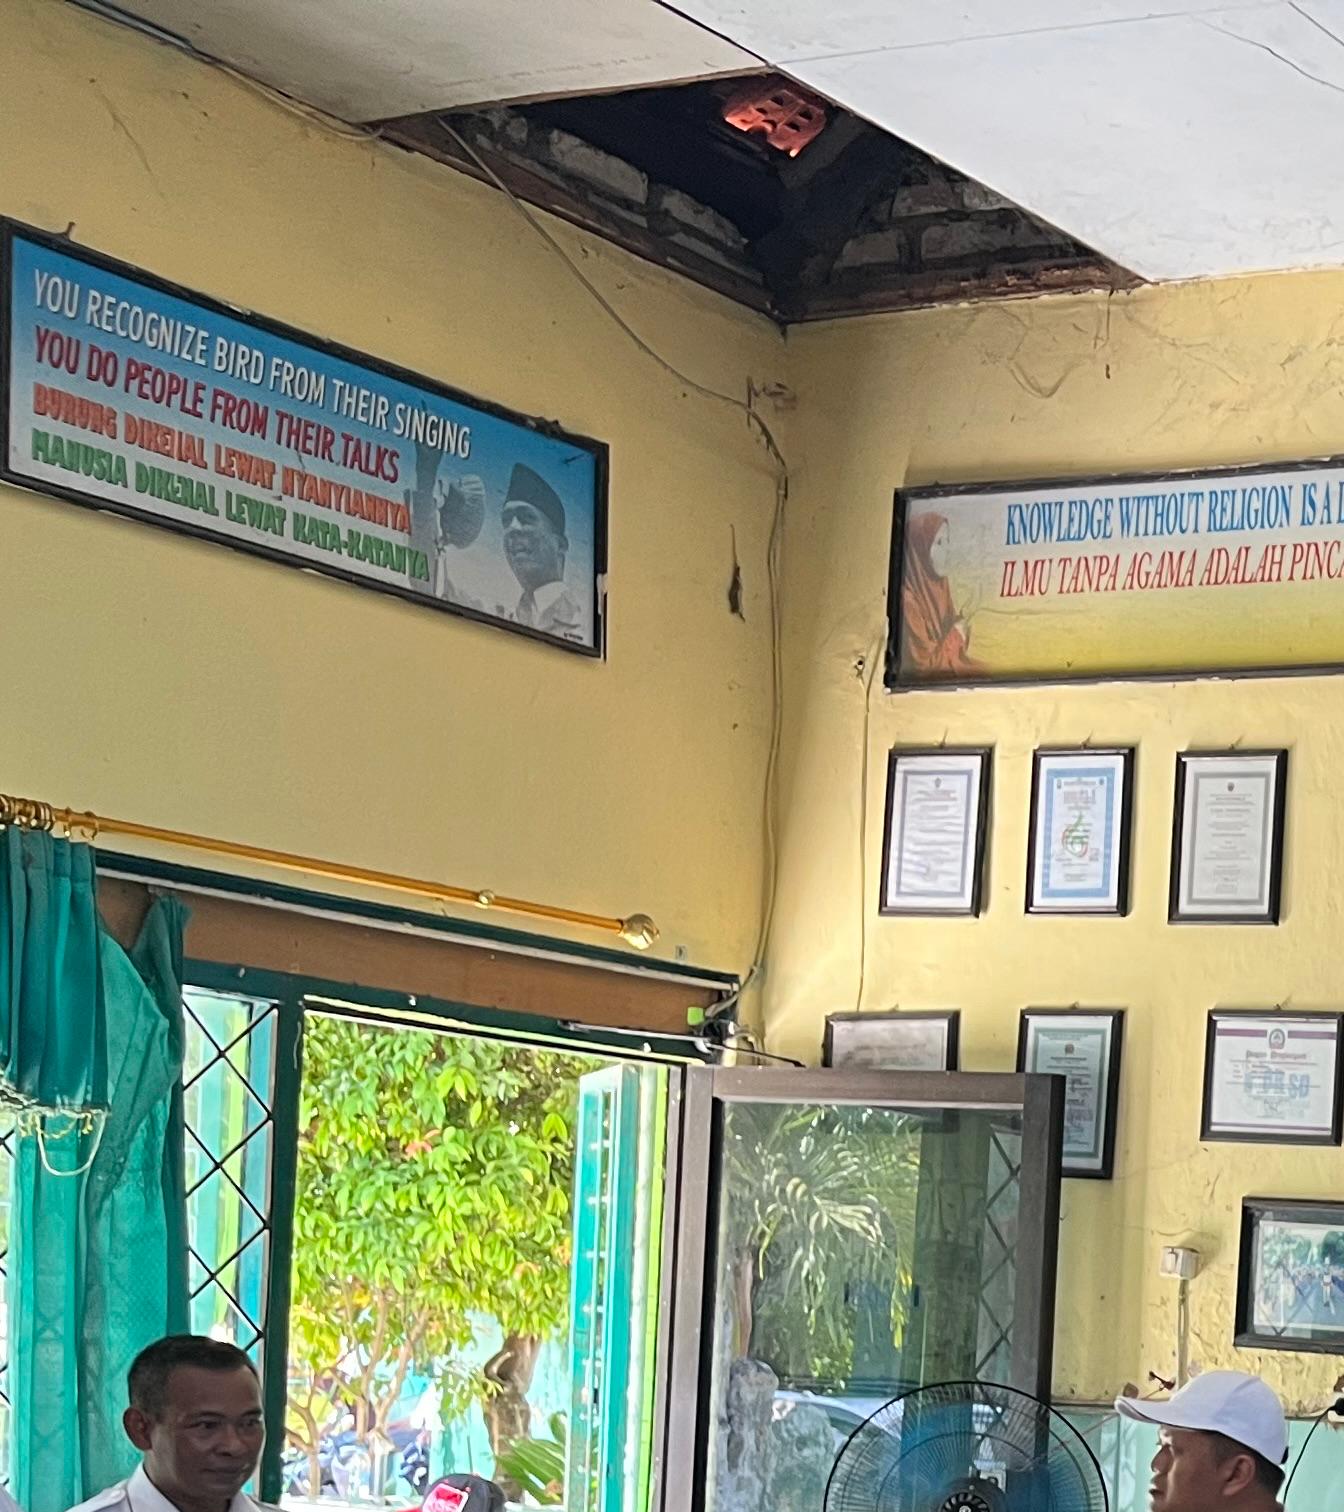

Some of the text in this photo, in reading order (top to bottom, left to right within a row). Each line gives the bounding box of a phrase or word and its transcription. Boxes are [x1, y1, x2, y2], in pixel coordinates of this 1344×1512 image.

[34, 269, 472, 460] YOU RECOGNIZE BIRD FROM THEIR SINGING
[35, 325, 400, 485] YOU DO PEOPLE FROM THEIR TALKS
[32, 428, 430, 582] MANUSIA DIKENAL LEWAT KATA-KATANYA
[214, 443, 277, 491] LEWAT
[1005, 497, 1114, 546] KNOWLEDGE
[1117, 491, 1205, 541] WITHOUT
[1206, 485, 1293, 534] RELIGION
[1300, 483, 1318, 526] IS
[1319, 482, 1334, 525] A
[1000, 557, 1053, 598] ILMU
[1057, 553, 1120, 595] TANPA
[1121, 548, 1197, 590] AGAMA
[1199, 543, 1288, 588] ADALAH
